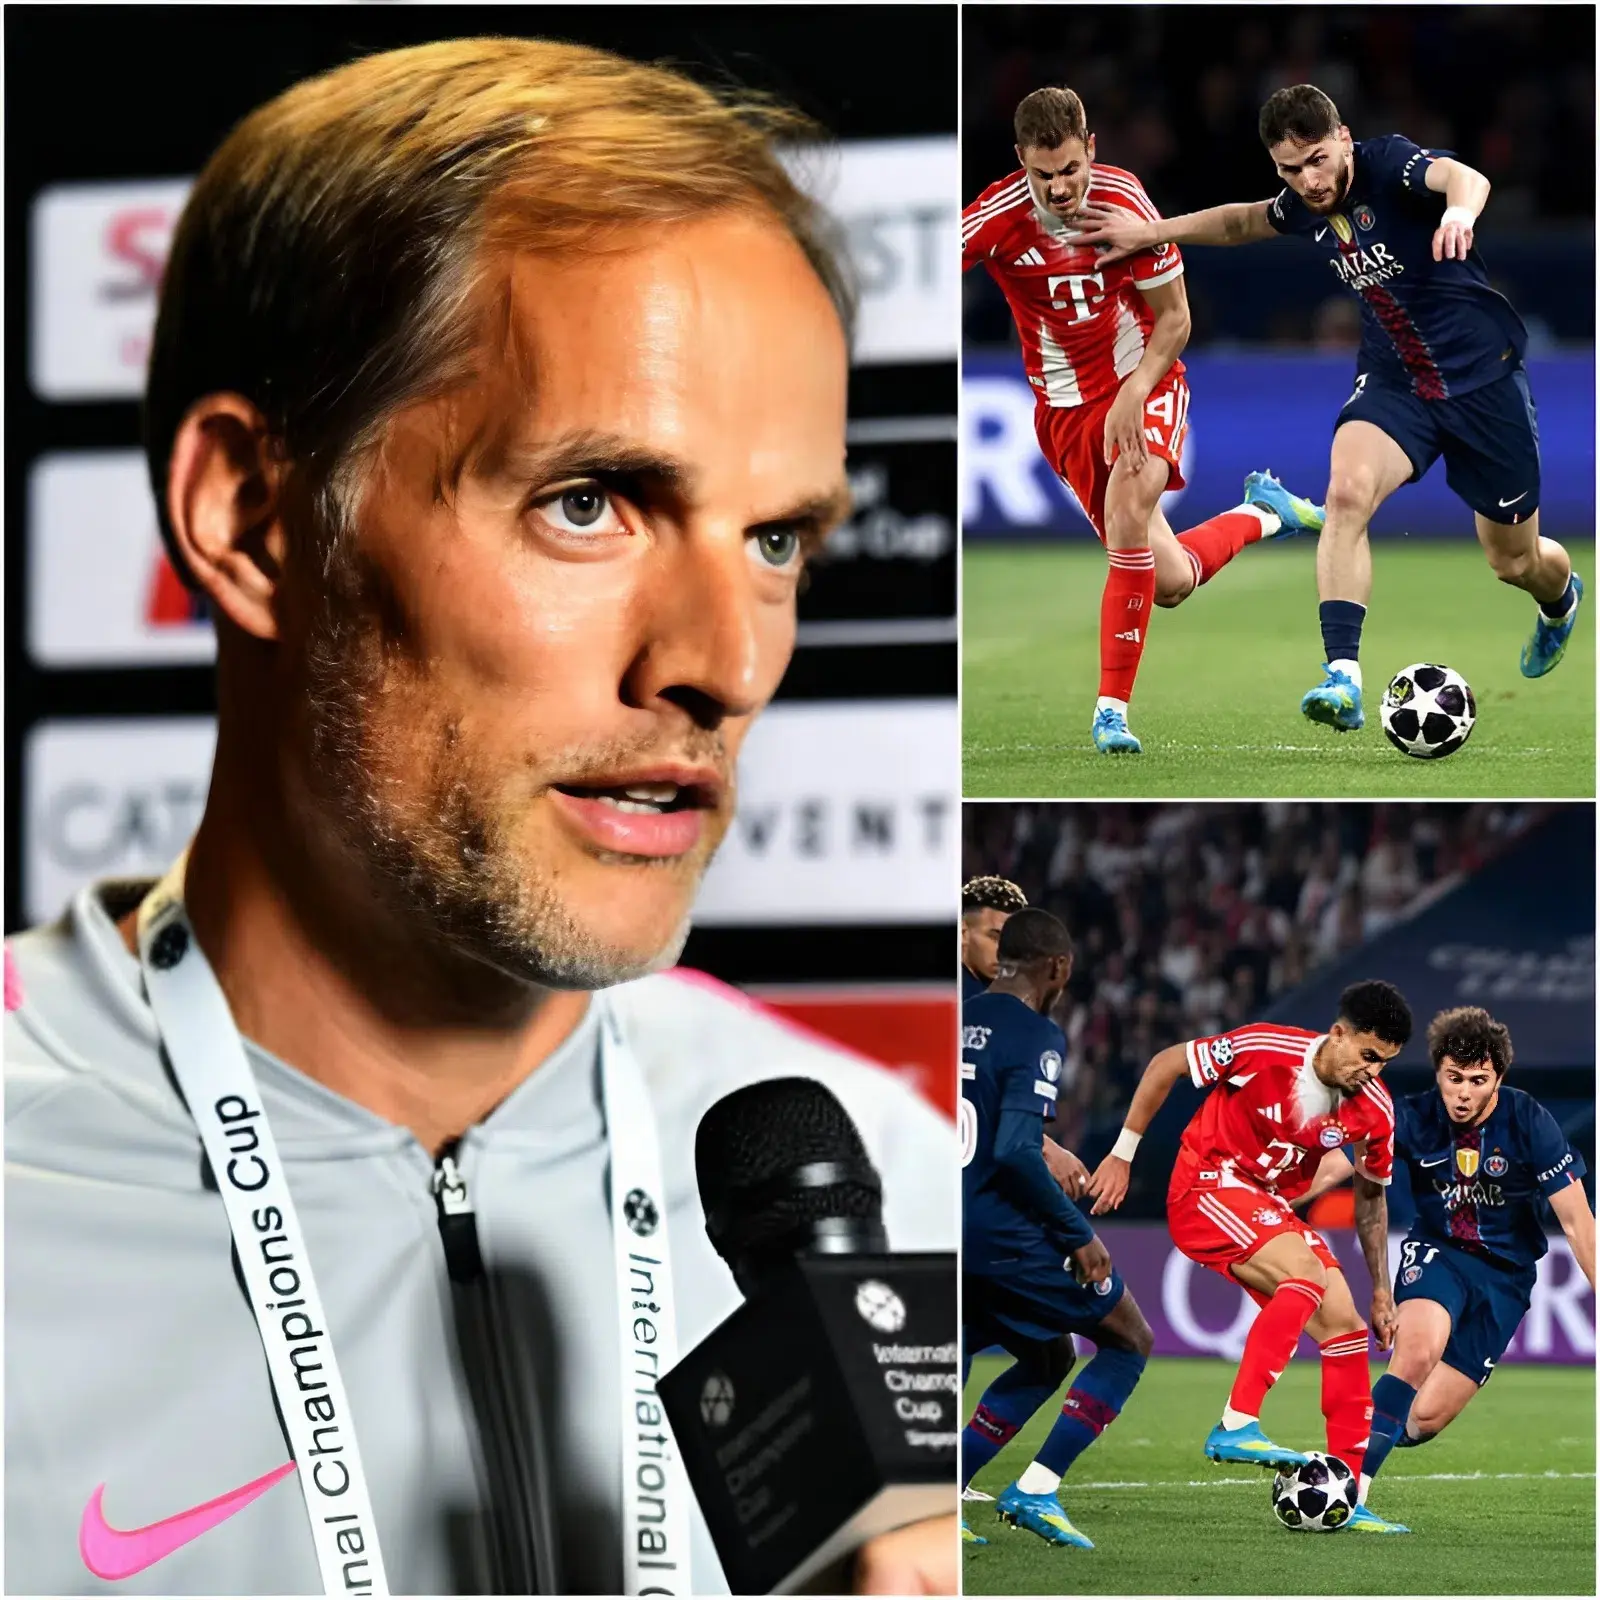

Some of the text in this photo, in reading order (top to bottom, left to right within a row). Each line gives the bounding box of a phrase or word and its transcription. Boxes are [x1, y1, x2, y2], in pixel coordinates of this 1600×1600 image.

[214, 1094, 373, 1596] nal Champions Cup
[628, 1252, 677, 1570] International
